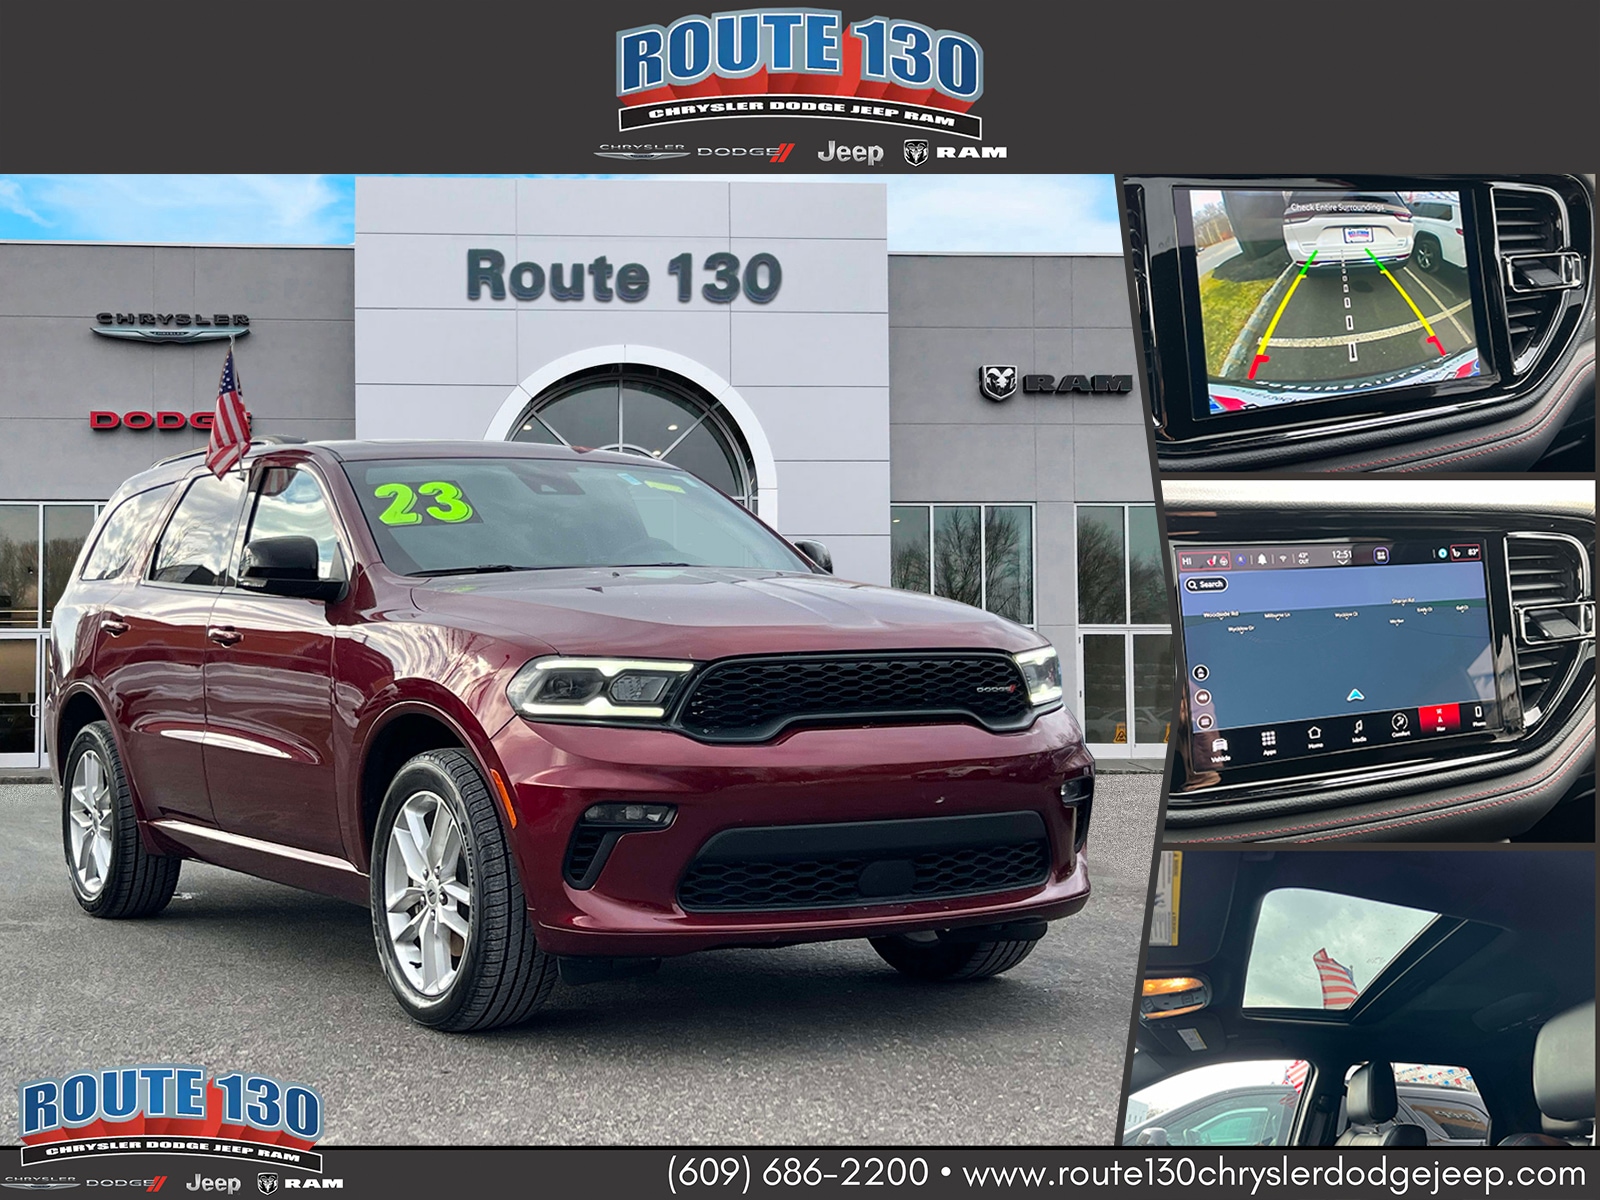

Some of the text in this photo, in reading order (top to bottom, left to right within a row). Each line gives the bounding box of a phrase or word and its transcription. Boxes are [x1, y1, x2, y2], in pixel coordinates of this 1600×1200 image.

[1291, 203, 1385, 212] Check Entire Surroundings
[467, 248, 782, 304] Route 130
[96, 312, 249, 326] CHRYSLER
[1023, 374, 1133, 394] RAM
[90, 411, 252, 430] DODG
[374, 481, 474, 526] 23
[1182, 557, 1192, 565] HI
[1332, 550, 1352, 559] 12:51
[1199, 580, 1224, 589] Search
